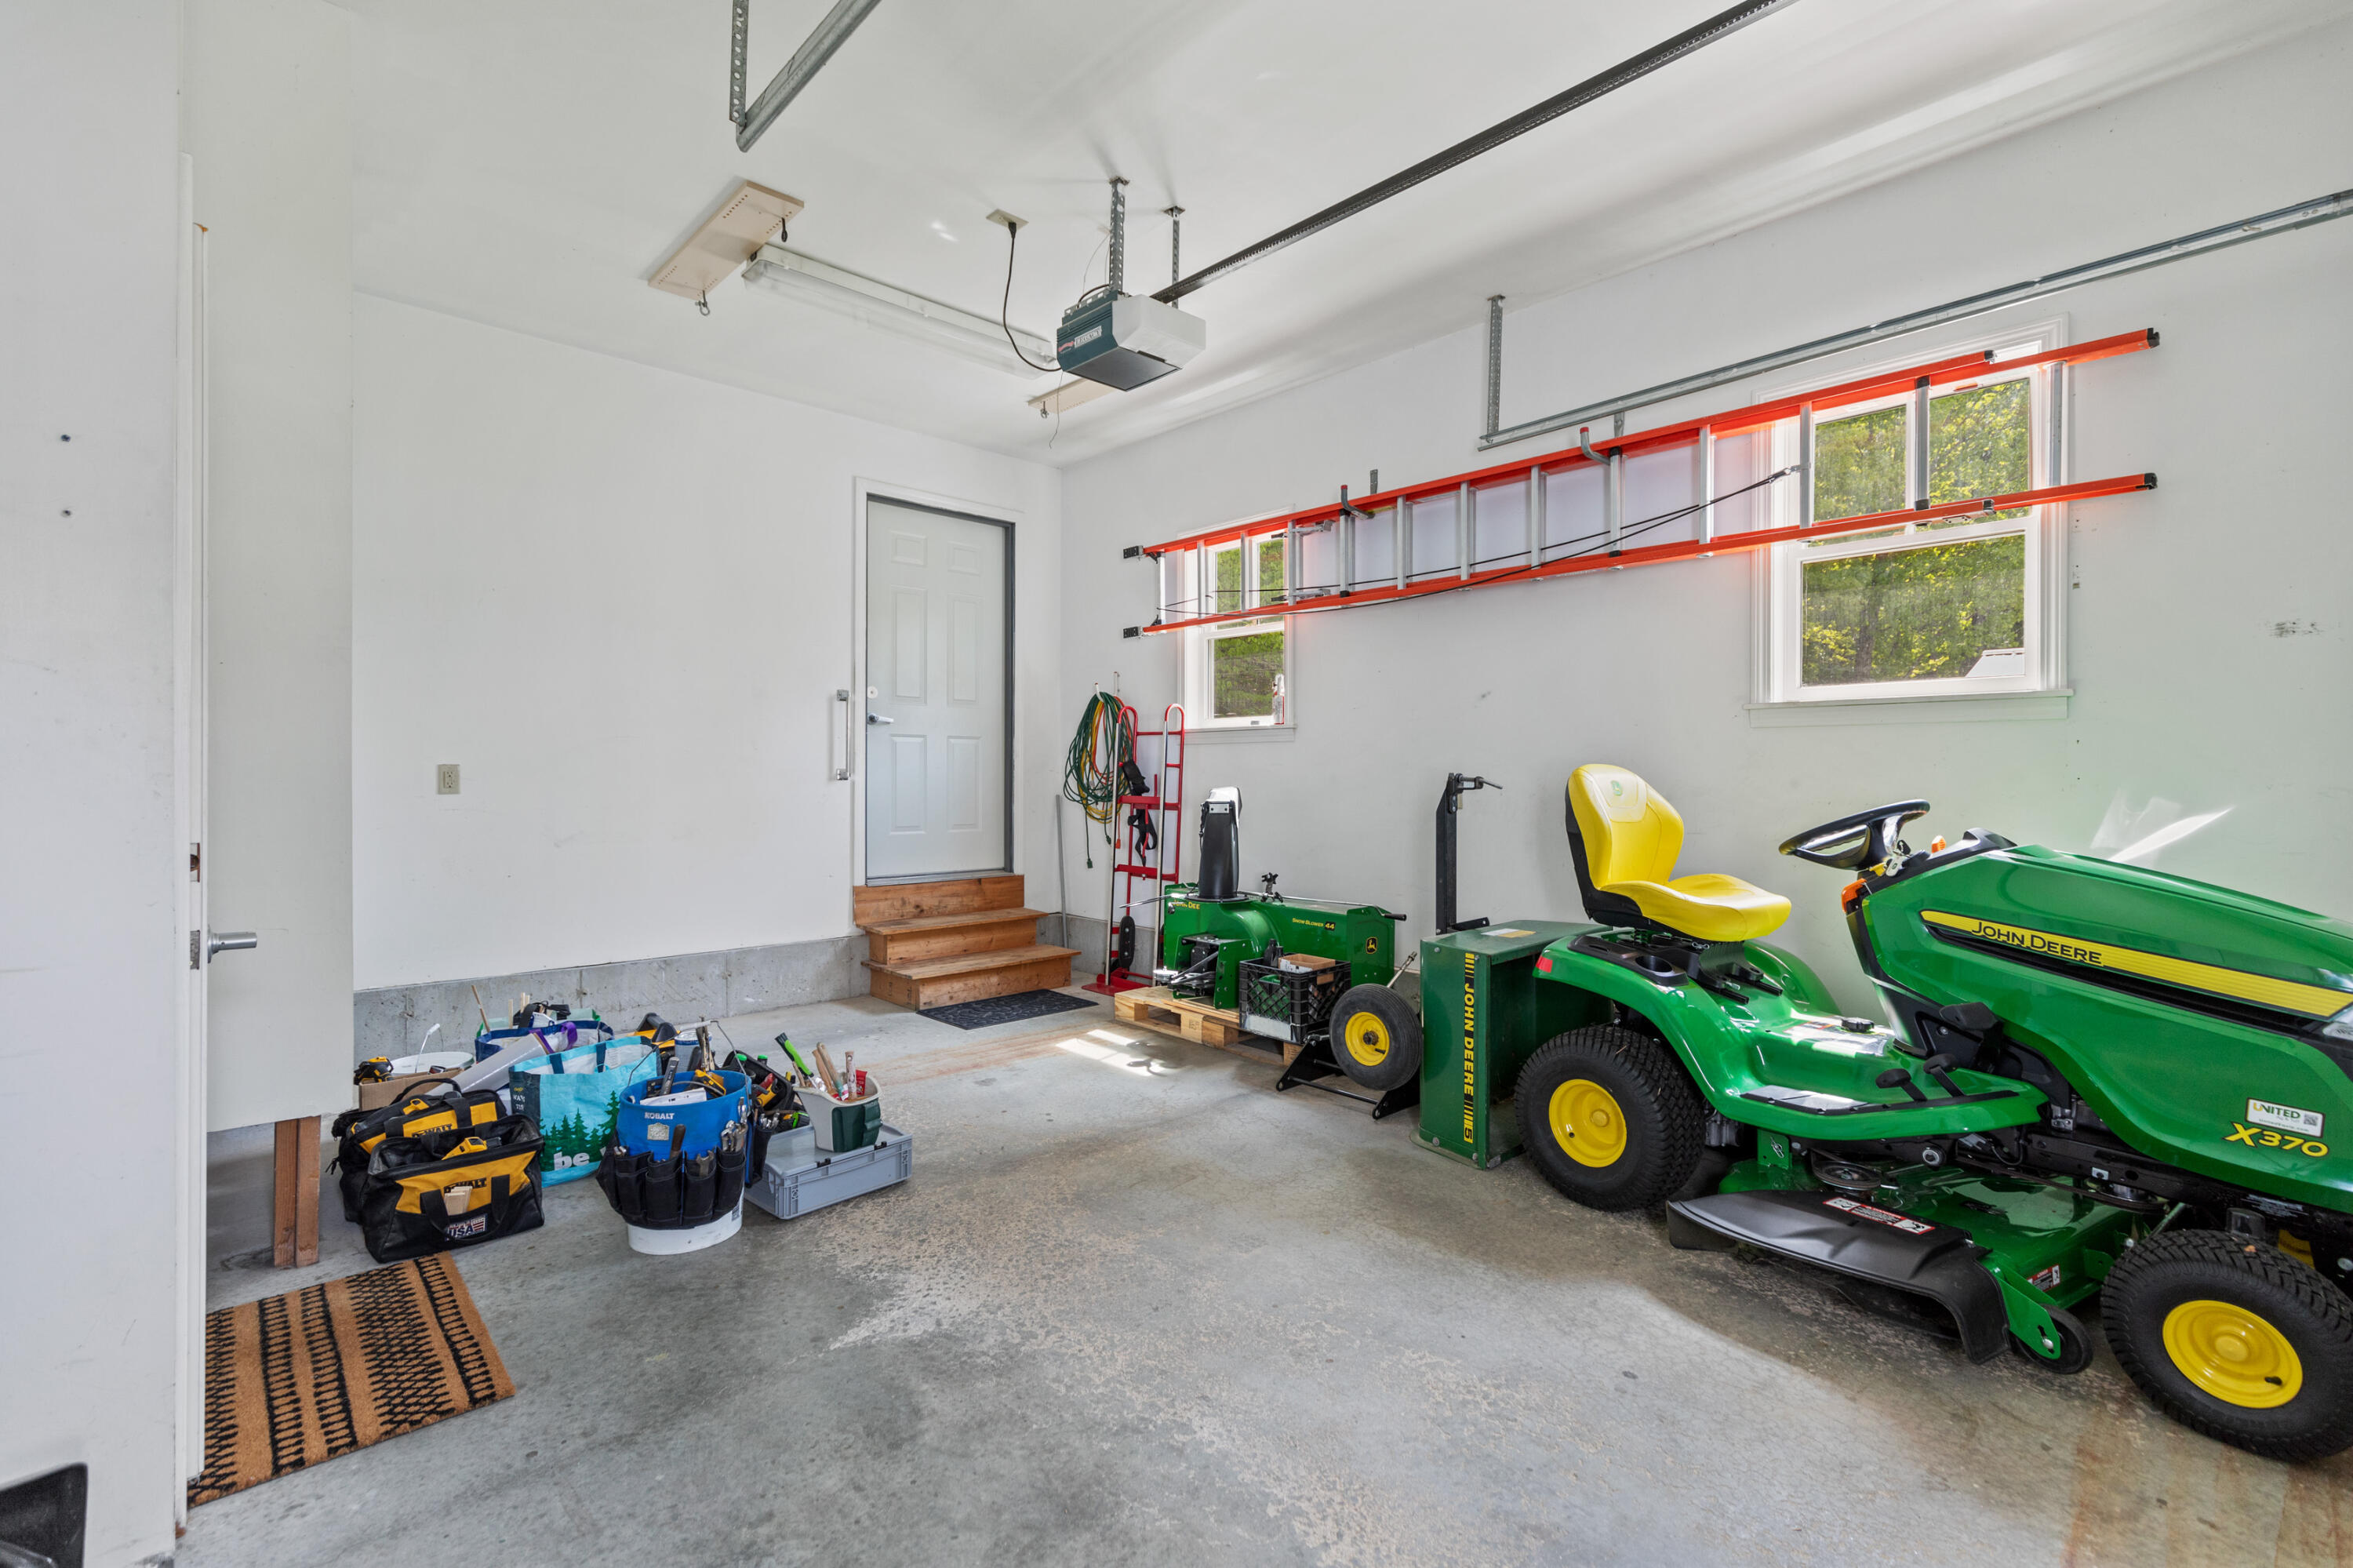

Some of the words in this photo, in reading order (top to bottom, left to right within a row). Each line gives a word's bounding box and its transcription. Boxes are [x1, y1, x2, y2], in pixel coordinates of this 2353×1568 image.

[1188, 901, 1200, 910] DEE
[1972, 922, 2025, 945] JOHN
[2031, 934, 2102, 964] DEERE
[1464, 983, 1475, 1031] JOHN
[1464, 1036, 1474, 1097] DEERE
[644, 1111, 675, 1120] KOBALT
[2253, 1102, 2301, 1119] UNITED
[2224, 1122, 2329, 1157] X370
[554, 1151, 590, 1170] be
[447, 1221, 474, 1239] USA
